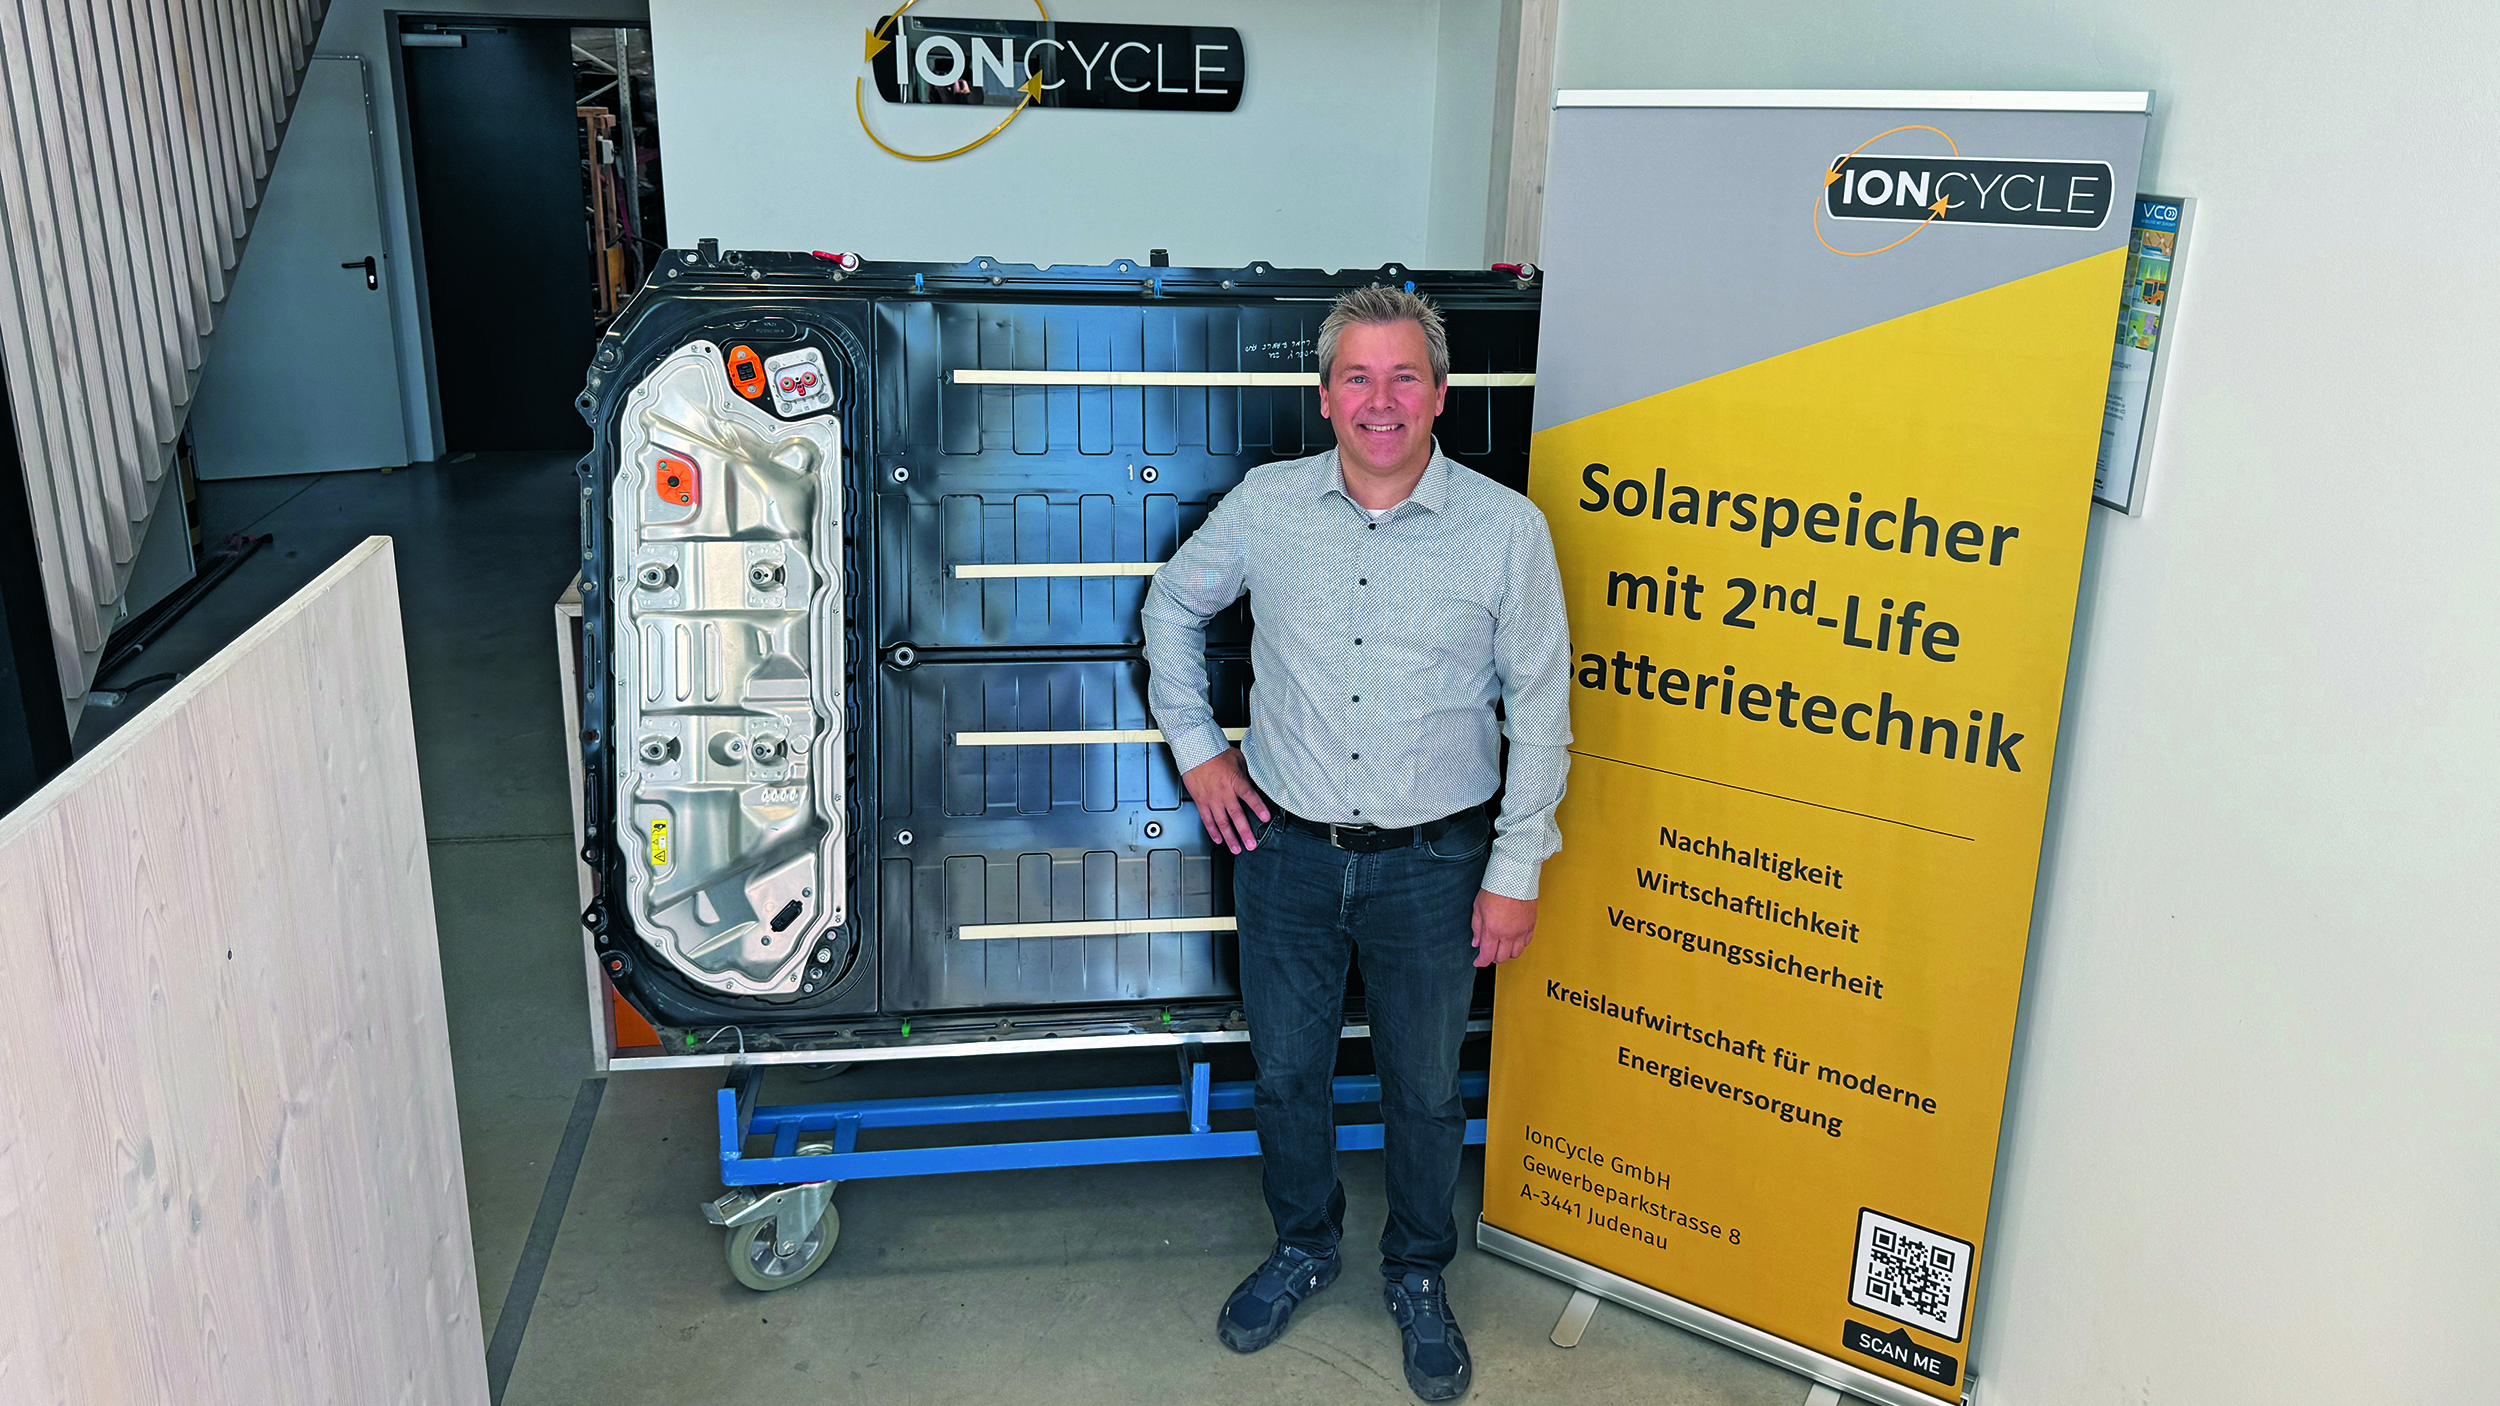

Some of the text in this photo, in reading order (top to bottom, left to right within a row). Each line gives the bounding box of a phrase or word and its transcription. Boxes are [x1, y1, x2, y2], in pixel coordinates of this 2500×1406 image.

[895, 34, 1229, 95] IONCYCLE
[1842, 168, 2099, 215] IONCYCLE
[1579, 463, 2019, 566] Solarspeicher
[1606, 566, 1704, 620] mit
[1570, 641, 2025, 773] atterietechnik
[1659, 826, 1844, 890] Nachhaltigkeit
[1636, 867, 1860, 944] Wirtschaftlichkeit
[1607, 906, 1884, 1000] Versorgungssicherheit
[1546, 979, 1937, 1115] Kreislaufwirtschaft für moderne
[1617, 1046, 1844, 1138] Energieversorgung
[1525, 1124, 1671, 1191] IonCycle GmbH
[1520, 1183, 1668, 1251] A-3441 Judenau
[1522, 1155, 1741, 1246] Gewerbeparkstrasse 8
[1858, 1332, 1942, 1376] SCAN ME
